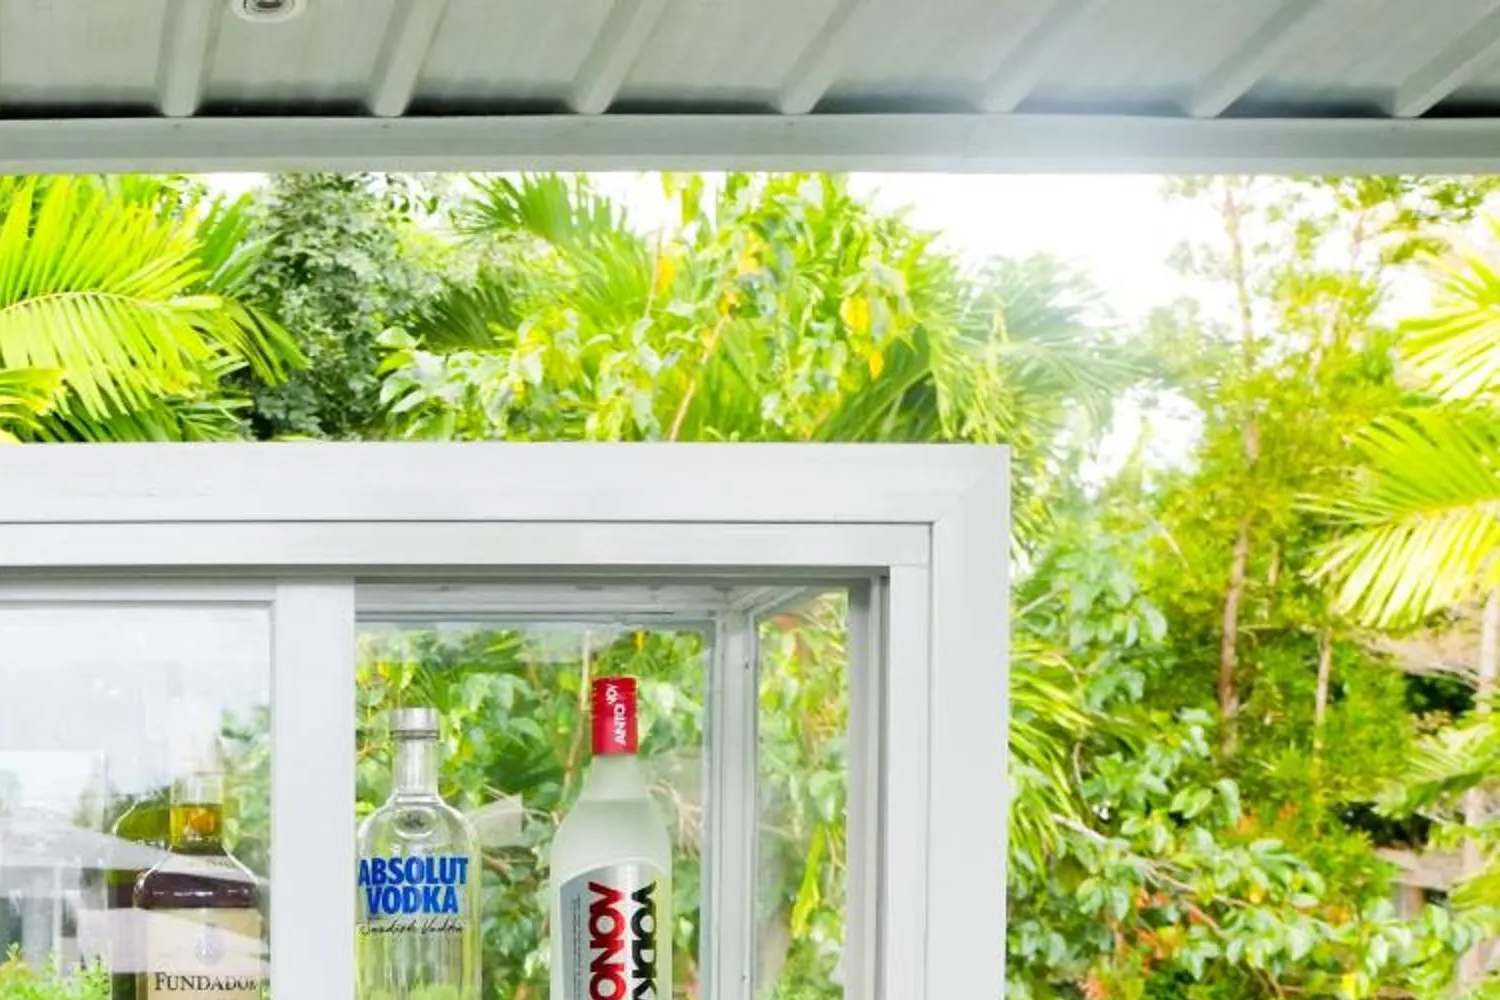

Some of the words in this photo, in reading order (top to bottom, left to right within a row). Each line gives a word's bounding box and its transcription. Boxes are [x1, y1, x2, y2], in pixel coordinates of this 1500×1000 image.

[358, 855, 469, 885] ABSOLUT
[366, 885, 459, 914] VODKA
[154, 972, 259, 991] FUNDADOR
